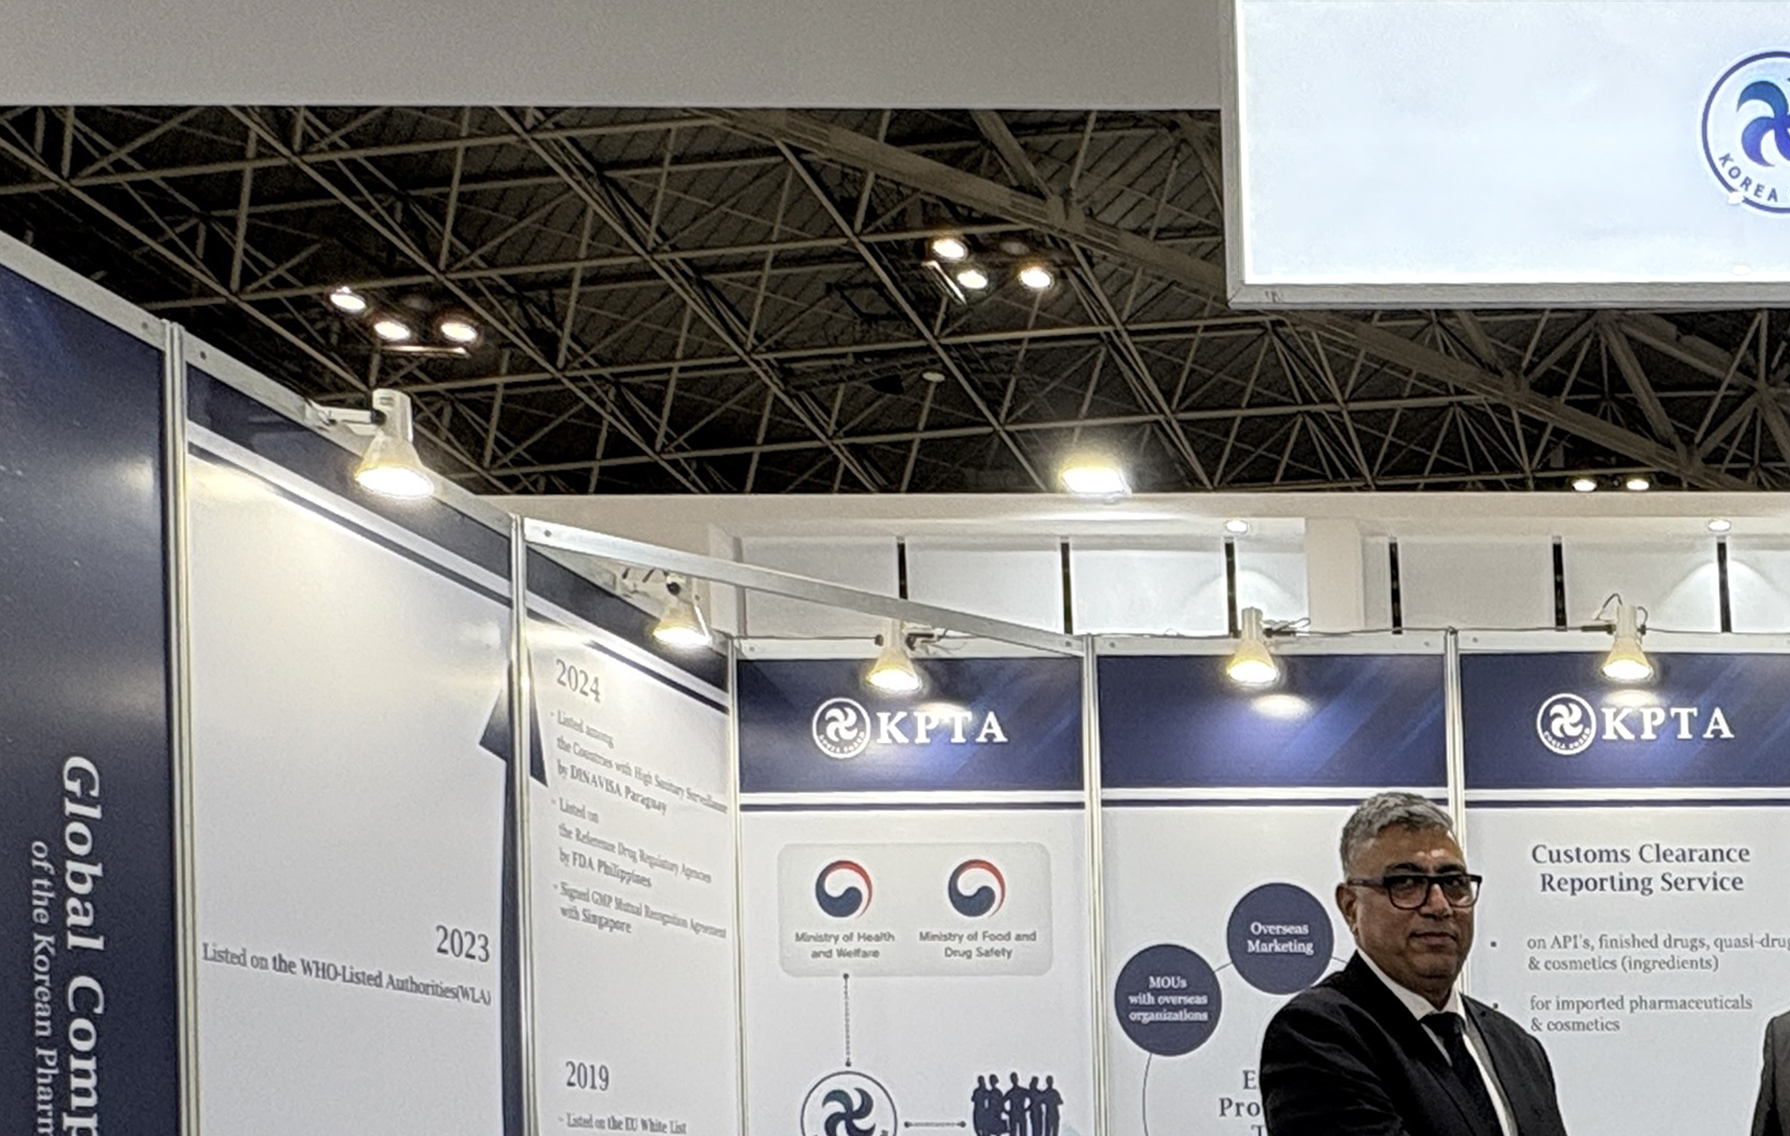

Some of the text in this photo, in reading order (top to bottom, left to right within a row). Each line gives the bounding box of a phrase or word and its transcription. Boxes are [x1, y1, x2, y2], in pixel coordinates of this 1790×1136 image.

[1718, 152, 1779, 203] KOREA
[555, 658, 602, 704] 2024
[557, 709, 584, 734] Listed
[876, 711, 1009, 745] KPTA
[1600, 706, 1736, 741] KPTA
[557, 735, 572, 753] the
[557, 759, 667, 816] by DINAVISA Paraguay
[558, 797, 587, 821] Listed
[31, 840, 55, 875] of
[62, 755, 105, 951] Global
[1531, 843, 1751, 864] Customs Clearance
[572, 850, 595, 872] FDA
[597, 858, 652, 888] Philippines
[1540, 871, 1744, 896] Reporting Service
[31, 878, 56, 925] the
[582, 908, 632, 934] Singapore
[1250, 921, 1310, 936] Overseas
[435, 924, 491, 963] 2023
[794, 931, 896, 945] Ministry of Health
[918, 930, 1037, 944] Ministry of Food and
[1246, 938, 1315, 957] Marketing
[1527, 937, 1547, 950] on
[1550, 933, 1595, 952] API's,
[1598, 933, 1659, 950] finished
[1662, 933, 1710, 953] drugs,
[811, 947, 880, 960] and Welfare
[944, 947, 1013, 961] Drug Safety
[1528, 955, 1720, 974] & cosmetics (ingredients)
[202, 942, 248, 968] Listed
[249, 955, 270, 971] on
[271, 952, 298, 975] the
[299, 957, 384, 990] WHO-Listed
[33, 932, 57, 1037] Korean
[1148, 975, 1188, 990] MOUs
[1128, 991, 1208, 1006] with overseas
[1529, 994, 1753, 1015] for imported pharmaceuticals
[1128, 1008, 1209, 1023] organizations
[1530, 1017, 1621, 1033] & cosmetics
[565, 1060, 610, 1092] 2019
[567, 1113, 593, 1130] Listed
[607, 1115, 624, 1131] the
[641, 1117, 667, 1134] White
